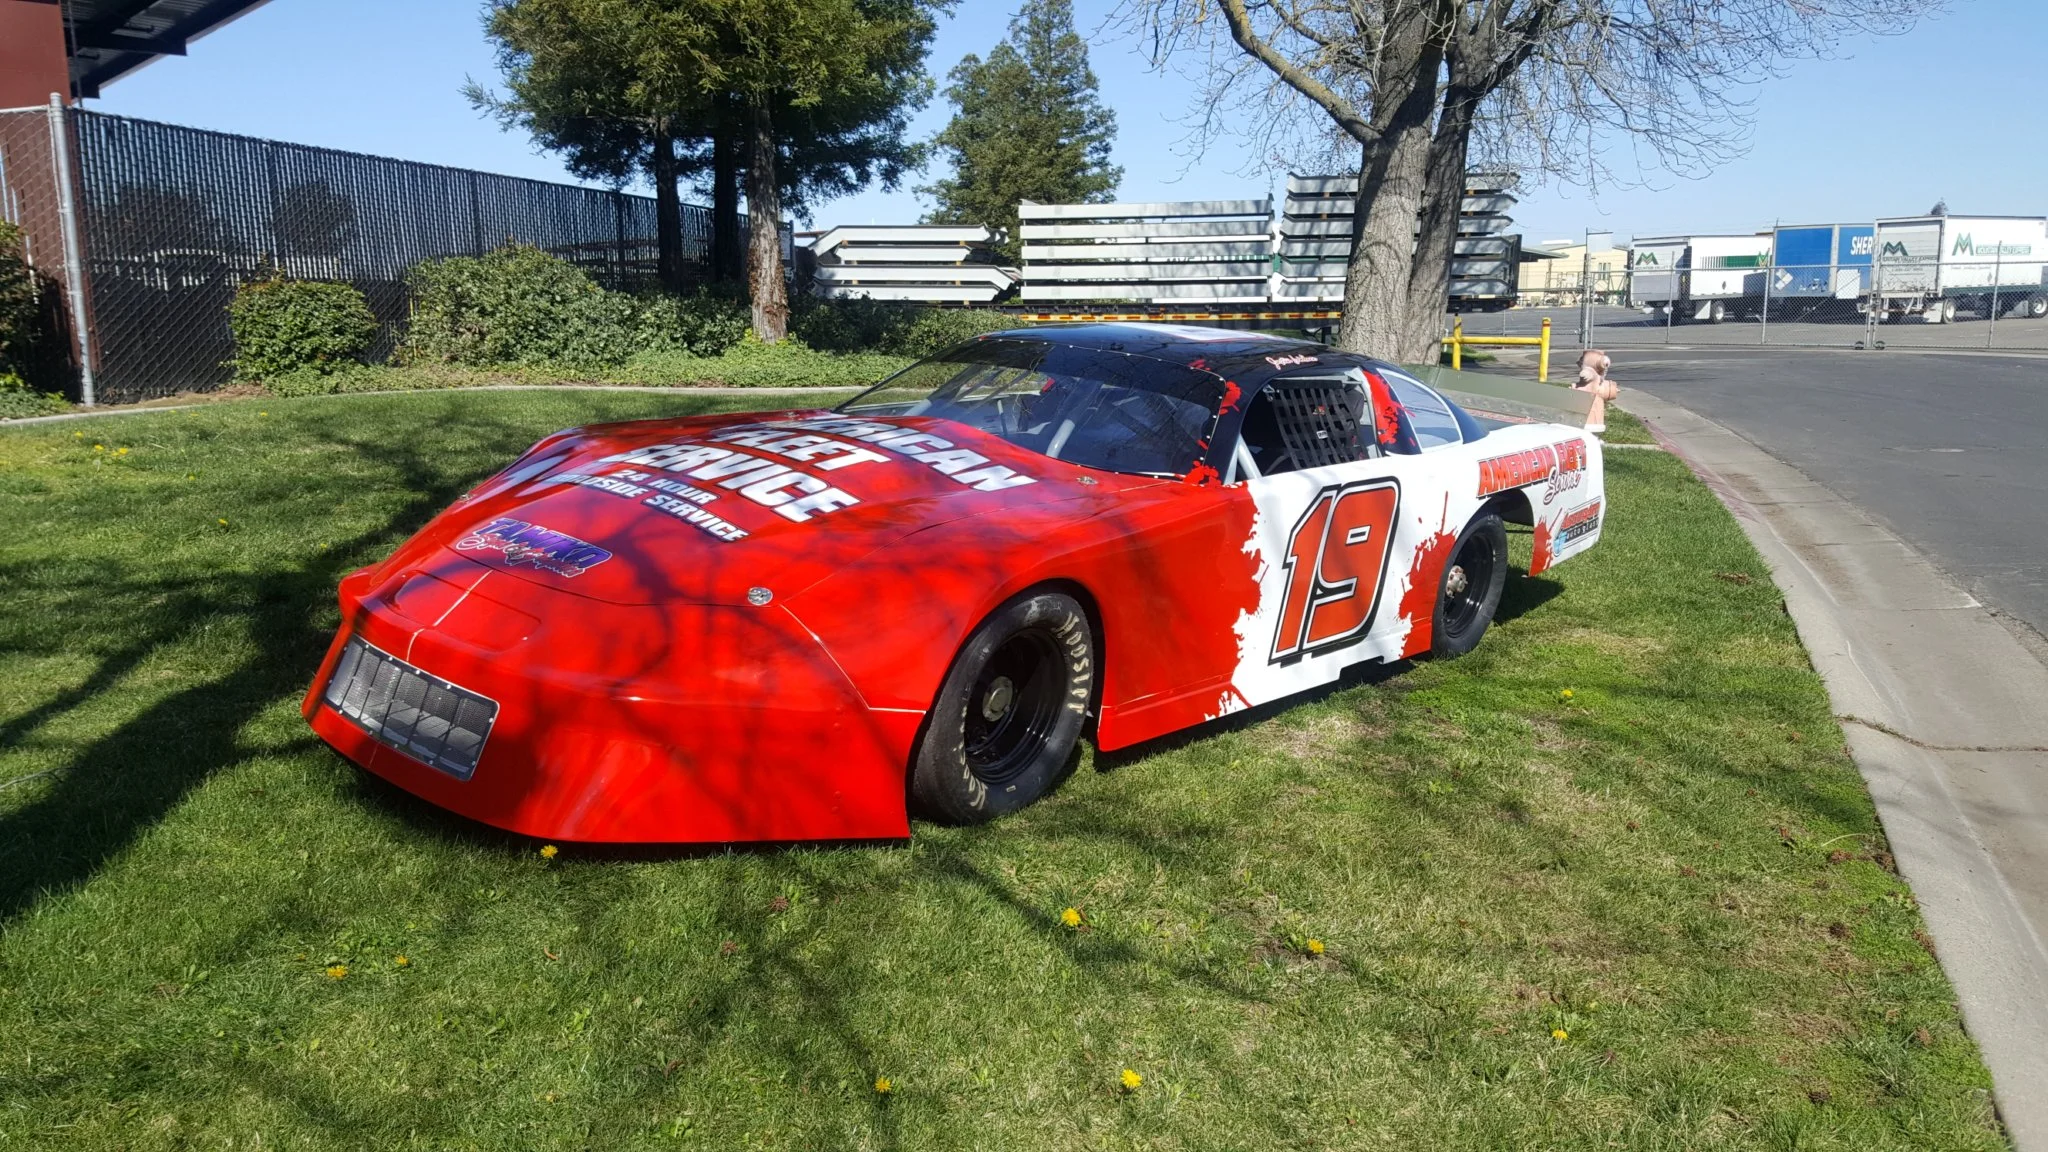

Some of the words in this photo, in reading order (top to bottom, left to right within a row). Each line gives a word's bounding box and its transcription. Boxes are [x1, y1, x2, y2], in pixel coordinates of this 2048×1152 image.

[706, 429, 891, 471] FLEET
[1476, 444, 1557, 500] AMERICAN
[598, 444, 863, 523] SERVICE
[609, 469, 652, 482] 24
[648, 478, 719, 505] HOUR
[643, 494, 749, 541] SERVICE
[1268, 476, 1400, 668] 19
